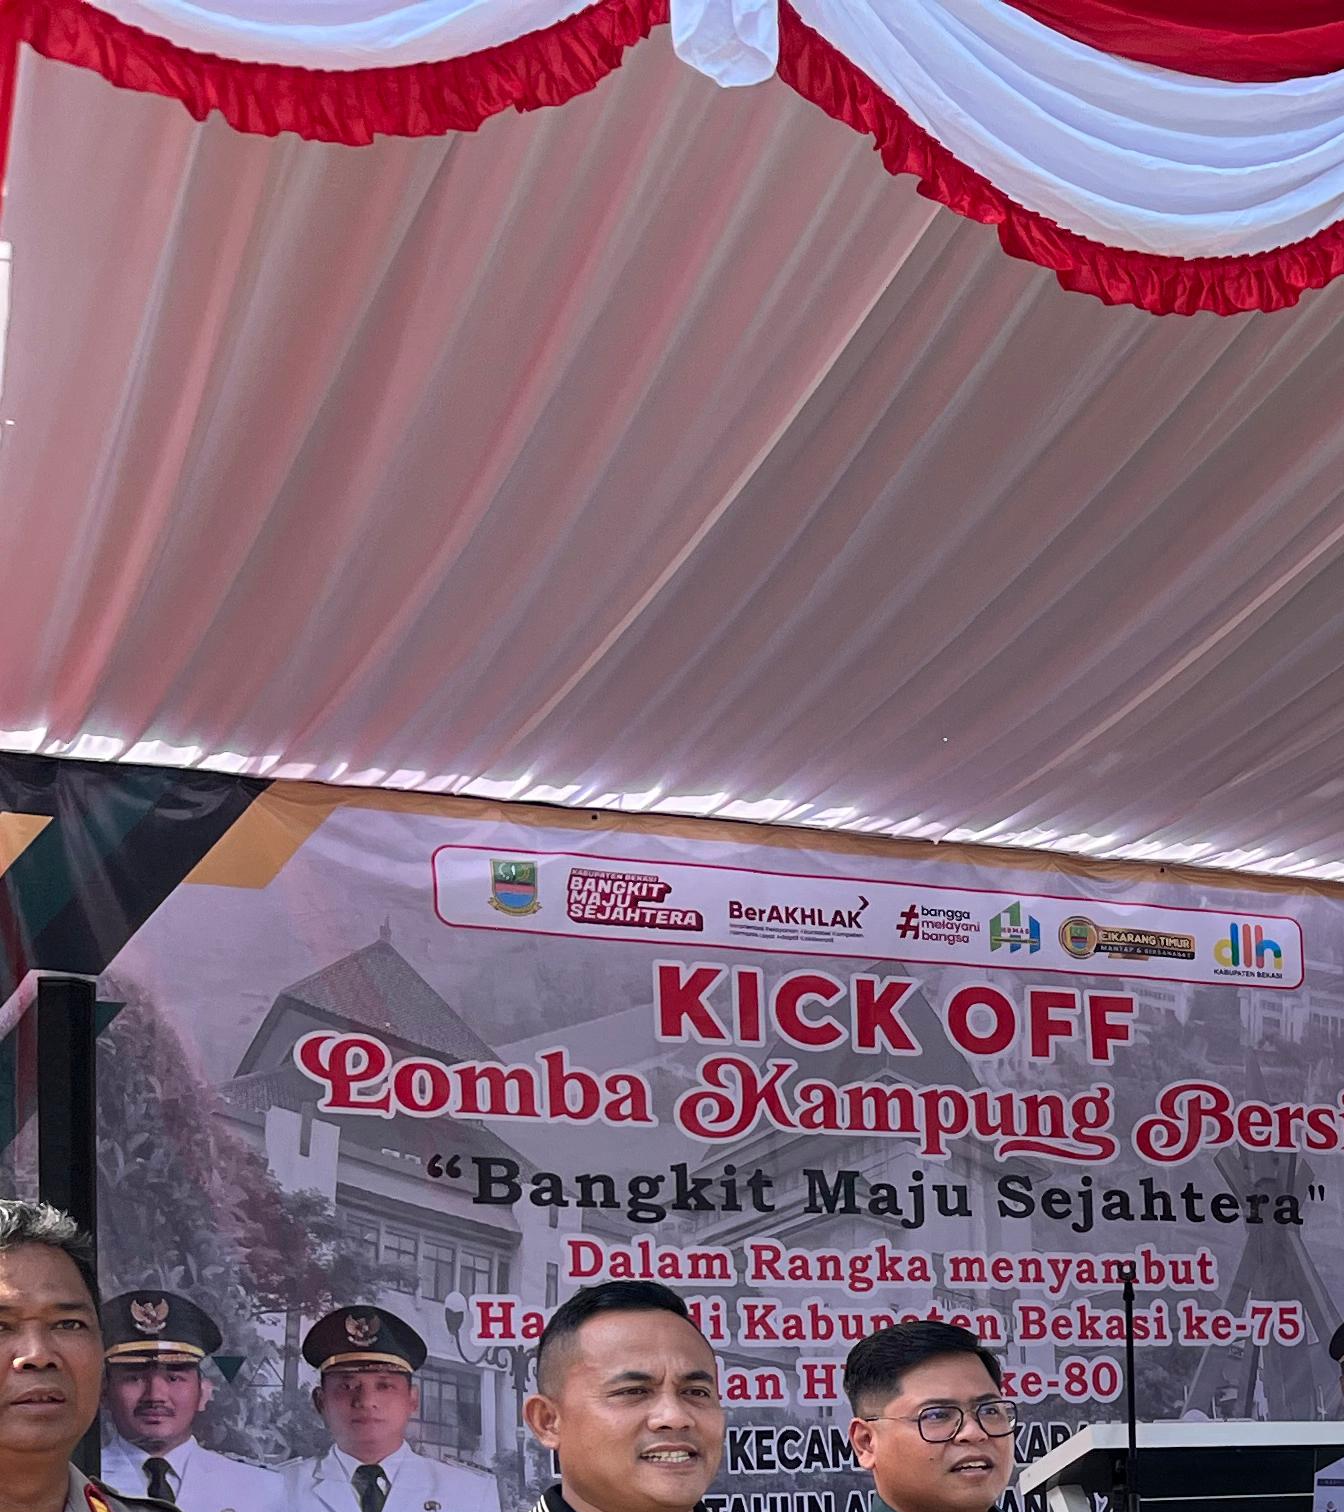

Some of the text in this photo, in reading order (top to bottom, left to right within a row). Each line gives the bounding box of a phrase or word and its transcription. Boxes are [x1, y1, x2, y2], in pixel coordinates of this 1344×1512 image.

[570, 876, 664, 897] BANGKIT
[569, 890, 631, 908] MAJU
[569, 904, 697, 926] SEJAHTERA
[729, 900, 863, 930] BerAKHLAK
[921, 905, 971, 921] bangga
[921, 919, 980, 934] melayani
[921, 931, 970, 946] bangsa
[1159, 936, 1191, 949] TIMUR
[657, 965, 1134, 1060] KICK OFF
[300, 1035, 653, 1122] Lomba
[680, 1057, 1117, 1161] Kampung
[803, 1168, 973, 1229] Maju
[567, 1239, 1214, 1295] Dalam Rangka menyambut
[1017, 1304, 1165, 1342] Bekasi
[1185, 1303, 1301, 1342] ke-75
